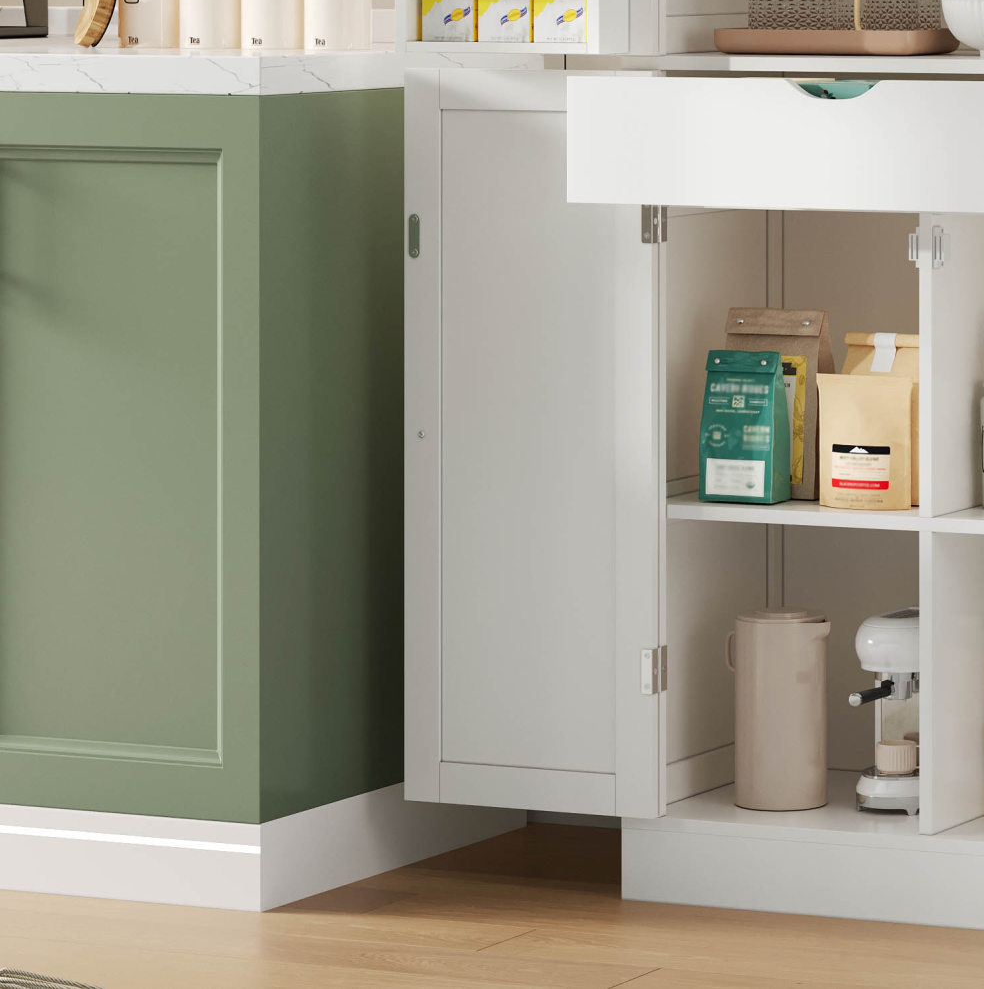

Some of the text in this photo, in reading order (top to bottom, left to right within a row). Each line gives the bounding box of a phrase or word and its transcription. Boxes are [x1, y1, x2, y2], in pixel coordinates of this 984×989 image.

[127, 36, 139, 44] Tea
[189, 36, 200, 44] Tea
[251, 37, 263, 45] Tea
[314, 37, 326, 46] Tea
